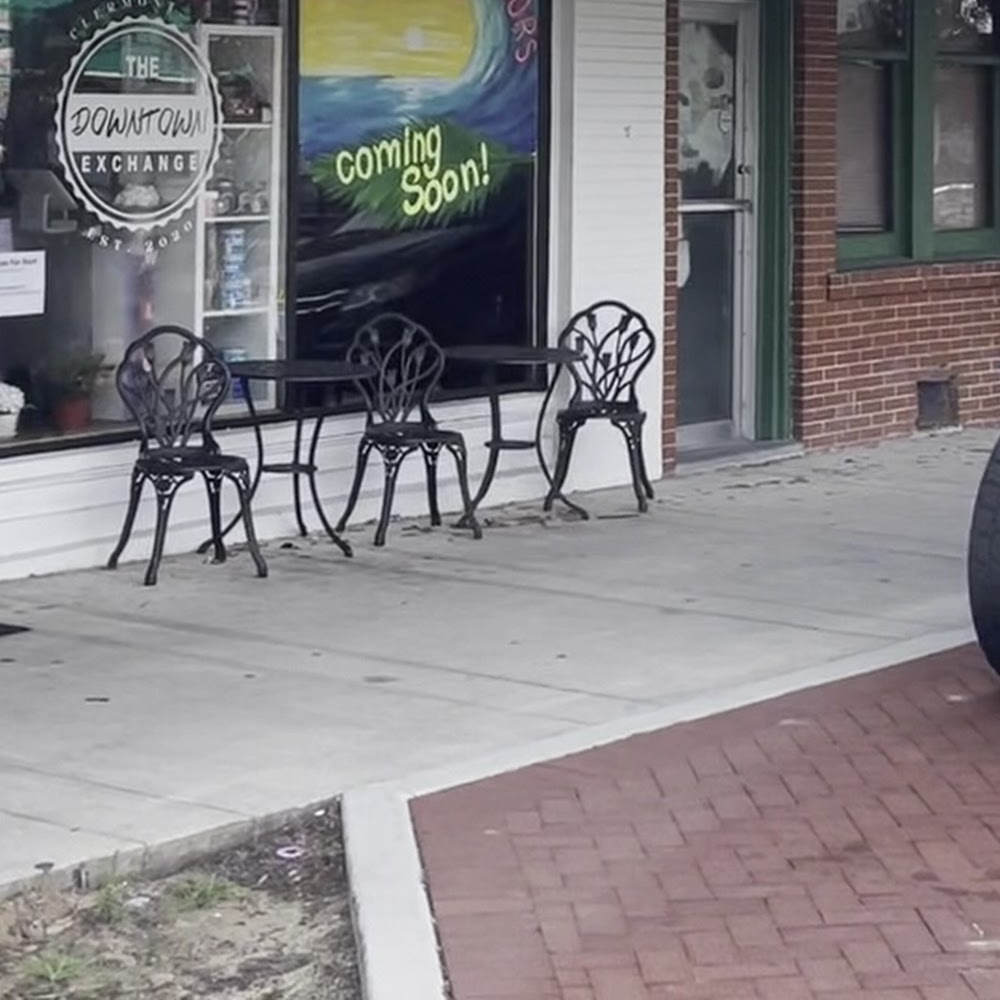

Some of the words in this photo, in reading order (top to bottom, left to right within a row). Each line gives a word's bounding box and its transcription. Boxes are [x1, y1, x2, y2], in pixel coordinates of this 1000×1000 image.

[126, 55, 160, 78] THE
[71, 105, 207, 139] DOWNTOWN
[81, 154, 198, 173] EXCHANGE
[336, 124, 443, 184] coming
[400, 142, 490, 216] Soon!
[85, 226, 131, 252] EST.
[144, 220, 193, 253] 2020
